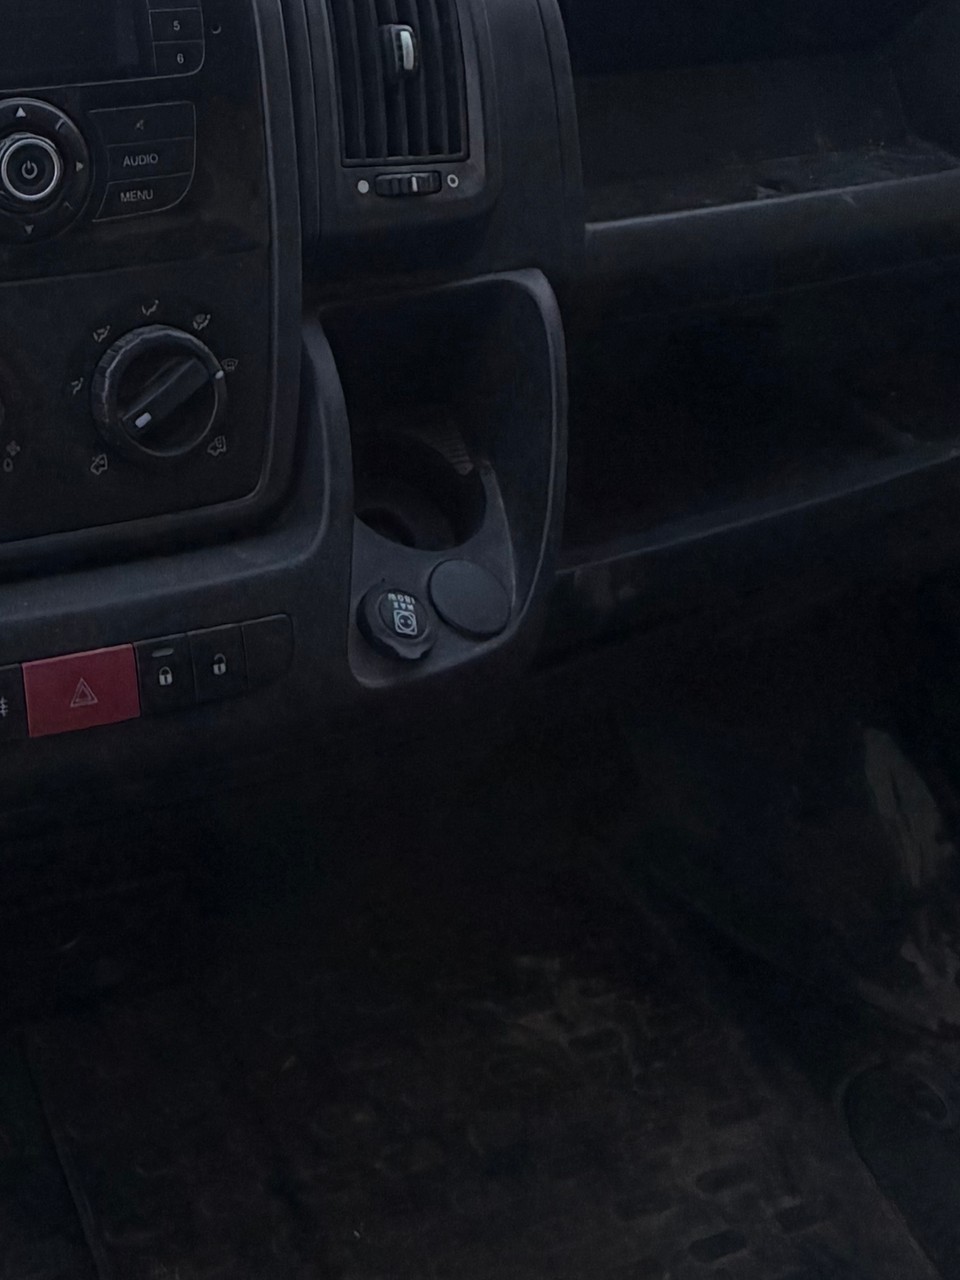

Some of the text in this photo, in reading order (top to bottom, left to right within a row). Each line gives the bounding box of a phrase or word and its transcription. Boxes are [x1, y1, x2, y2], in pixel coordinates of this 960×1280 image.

[173, 20, 181, 31] 5
[177, 52, 185, 64] 6
[123, 152, 159, 167] AUDIO
[120, 188, 154, 203] MENU
